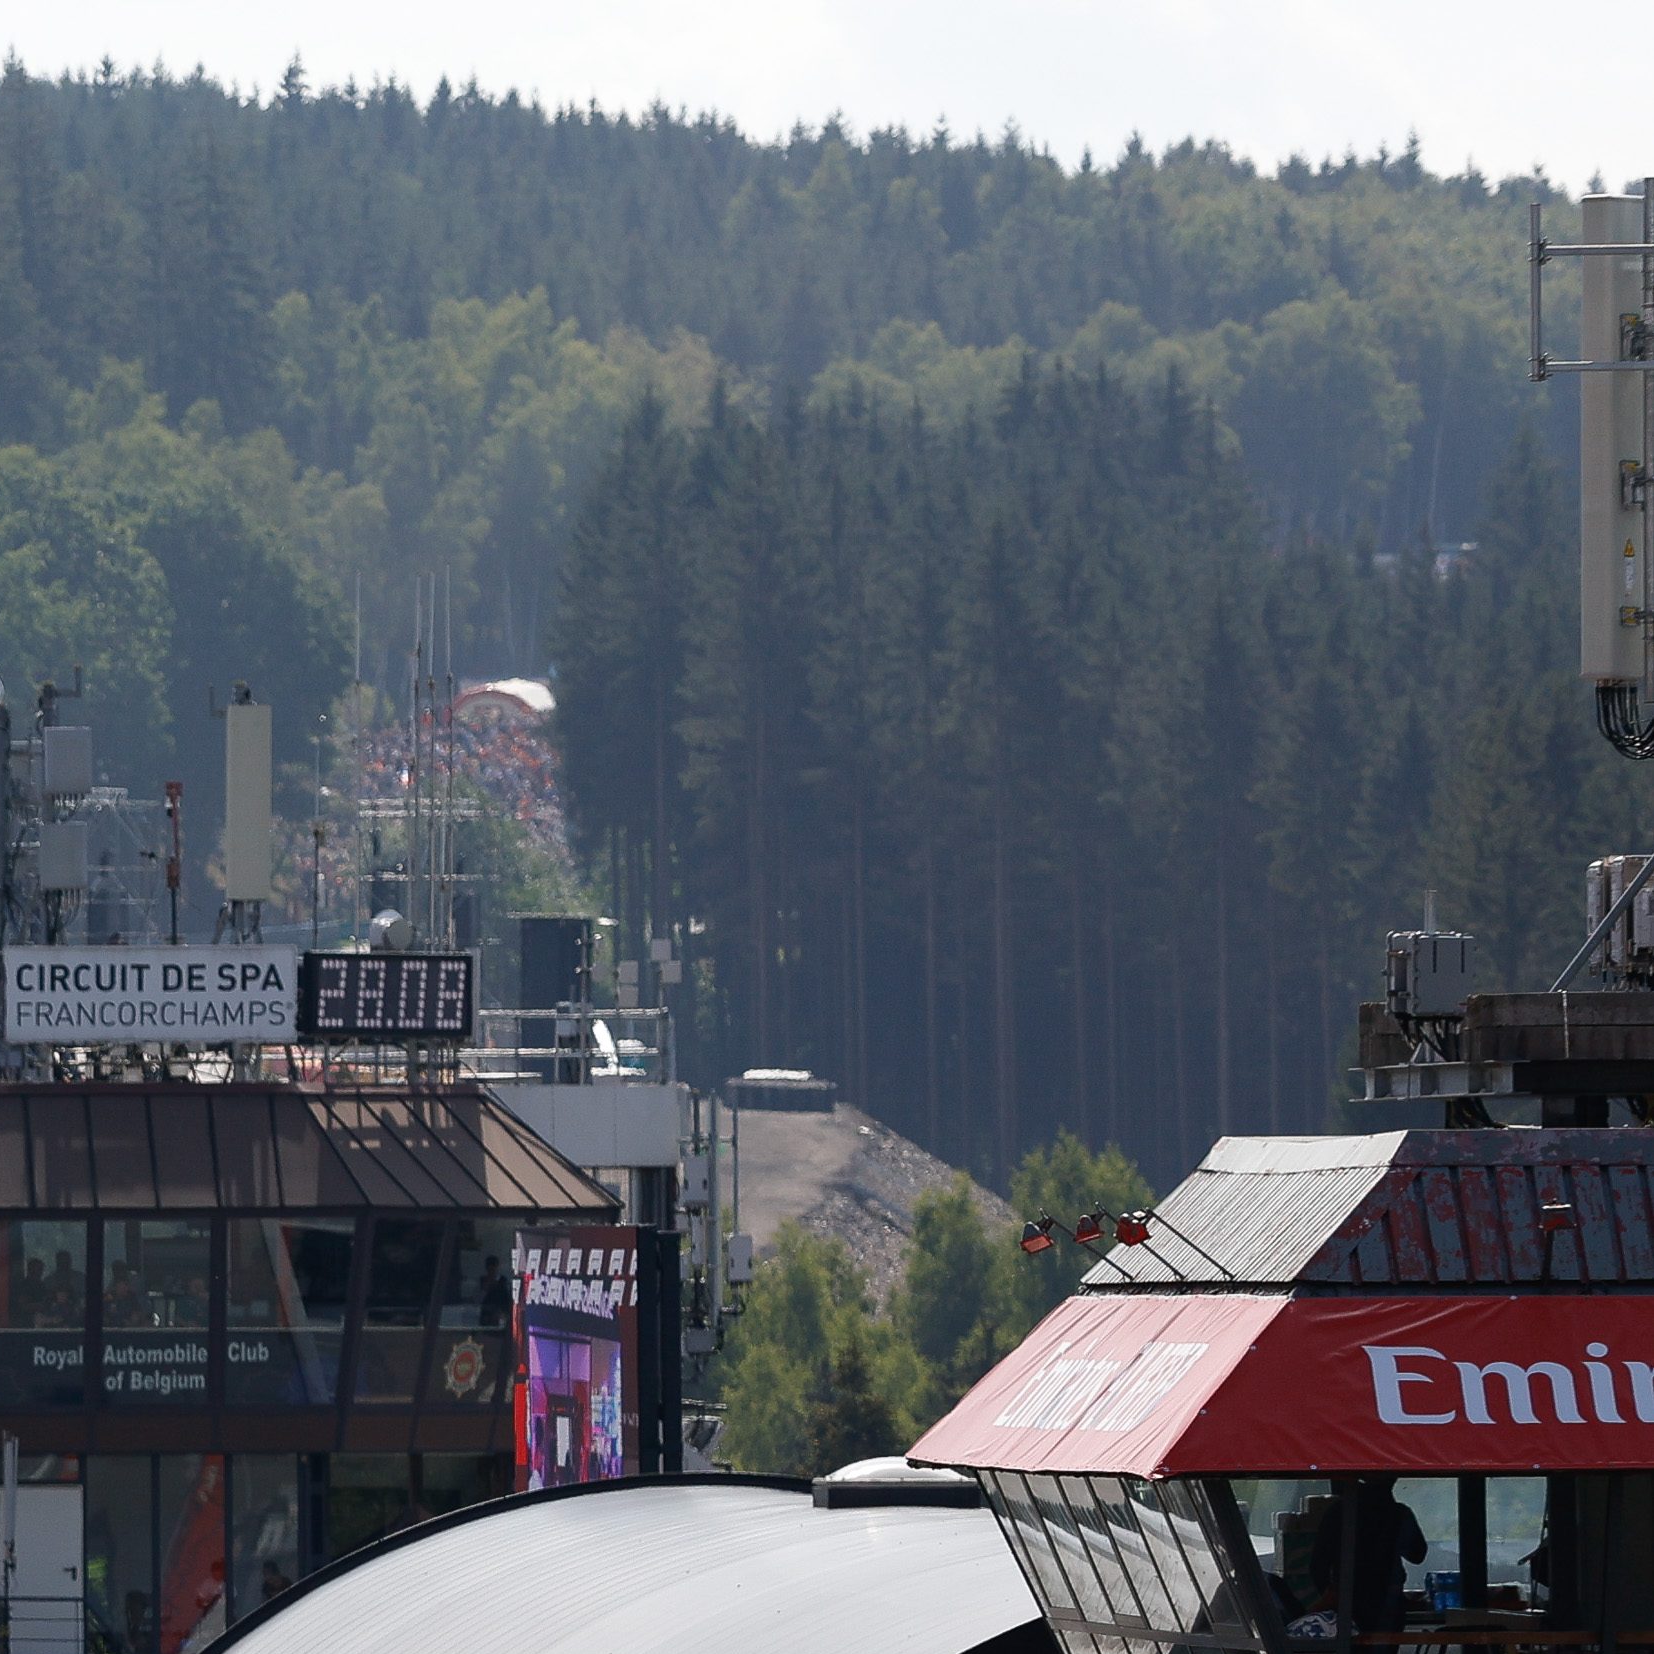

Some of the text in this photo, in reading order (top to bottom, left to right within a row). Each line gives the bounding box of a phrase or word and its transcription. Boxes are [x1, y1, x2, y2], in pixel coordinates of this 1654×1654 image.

[14, 962, 286, 993] CIRCUIT DE SPA
[15, 999, 289, 1028] FRANCORCHAMPS
[33, 1341, 270, 1370] Royal Automobile Club
[105, 1370, 206, 1394] of Belgium
